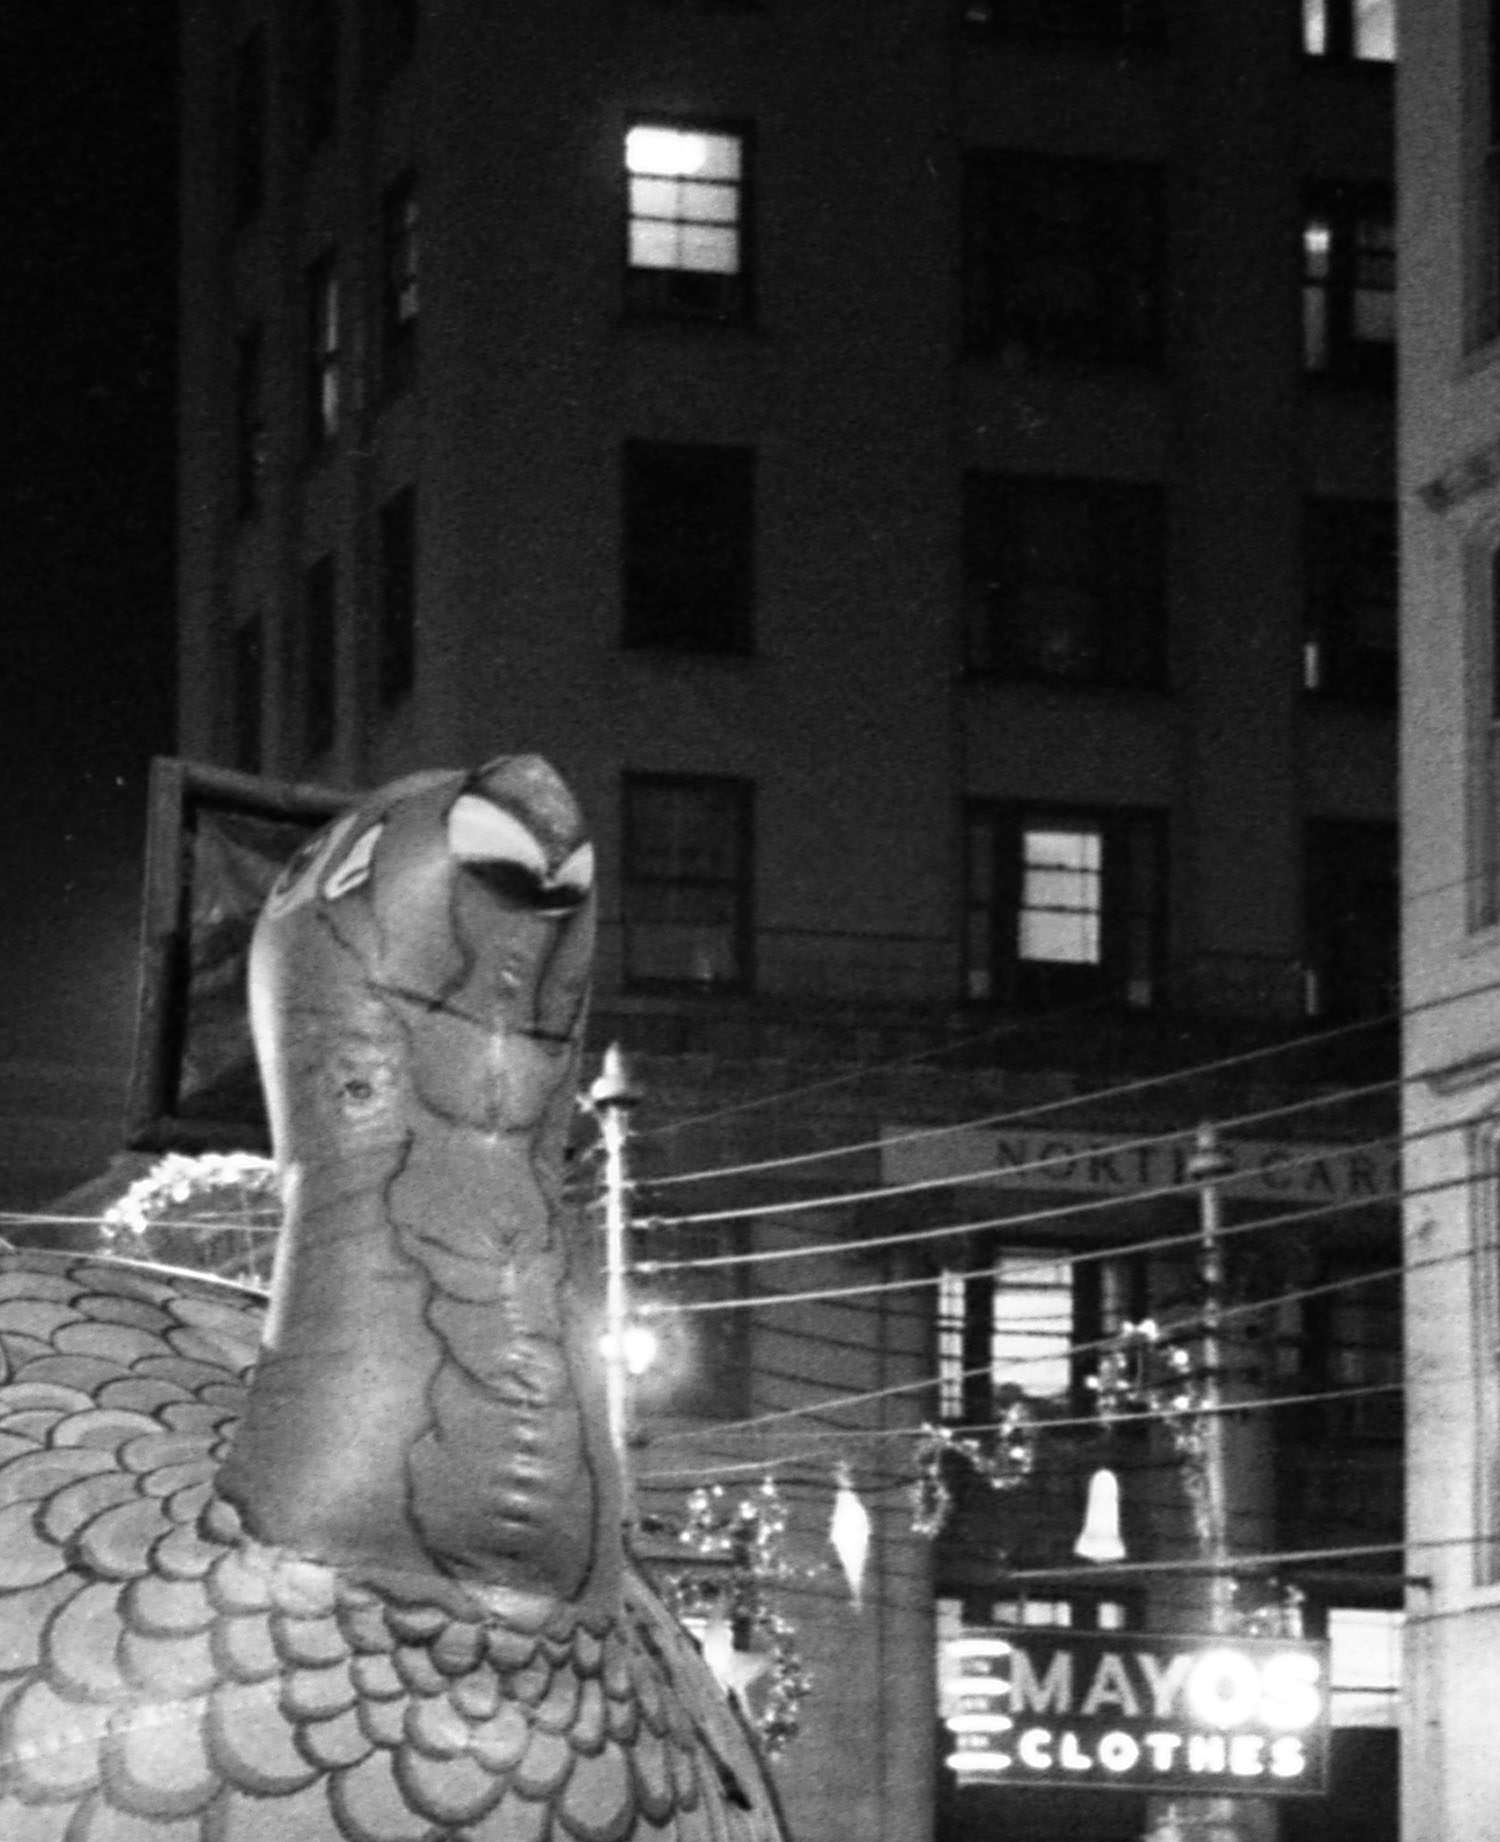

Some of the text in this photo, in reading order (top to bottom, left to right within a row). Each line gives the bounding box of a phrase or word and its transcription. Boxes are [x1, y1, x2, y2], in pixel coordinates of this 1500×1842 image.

[1260, 1149, 1400, 1194] CAR
[1009, 1647, 1321, 1730] MAYOS
[1018, 1728, 1305, 1777] CLOTHES
